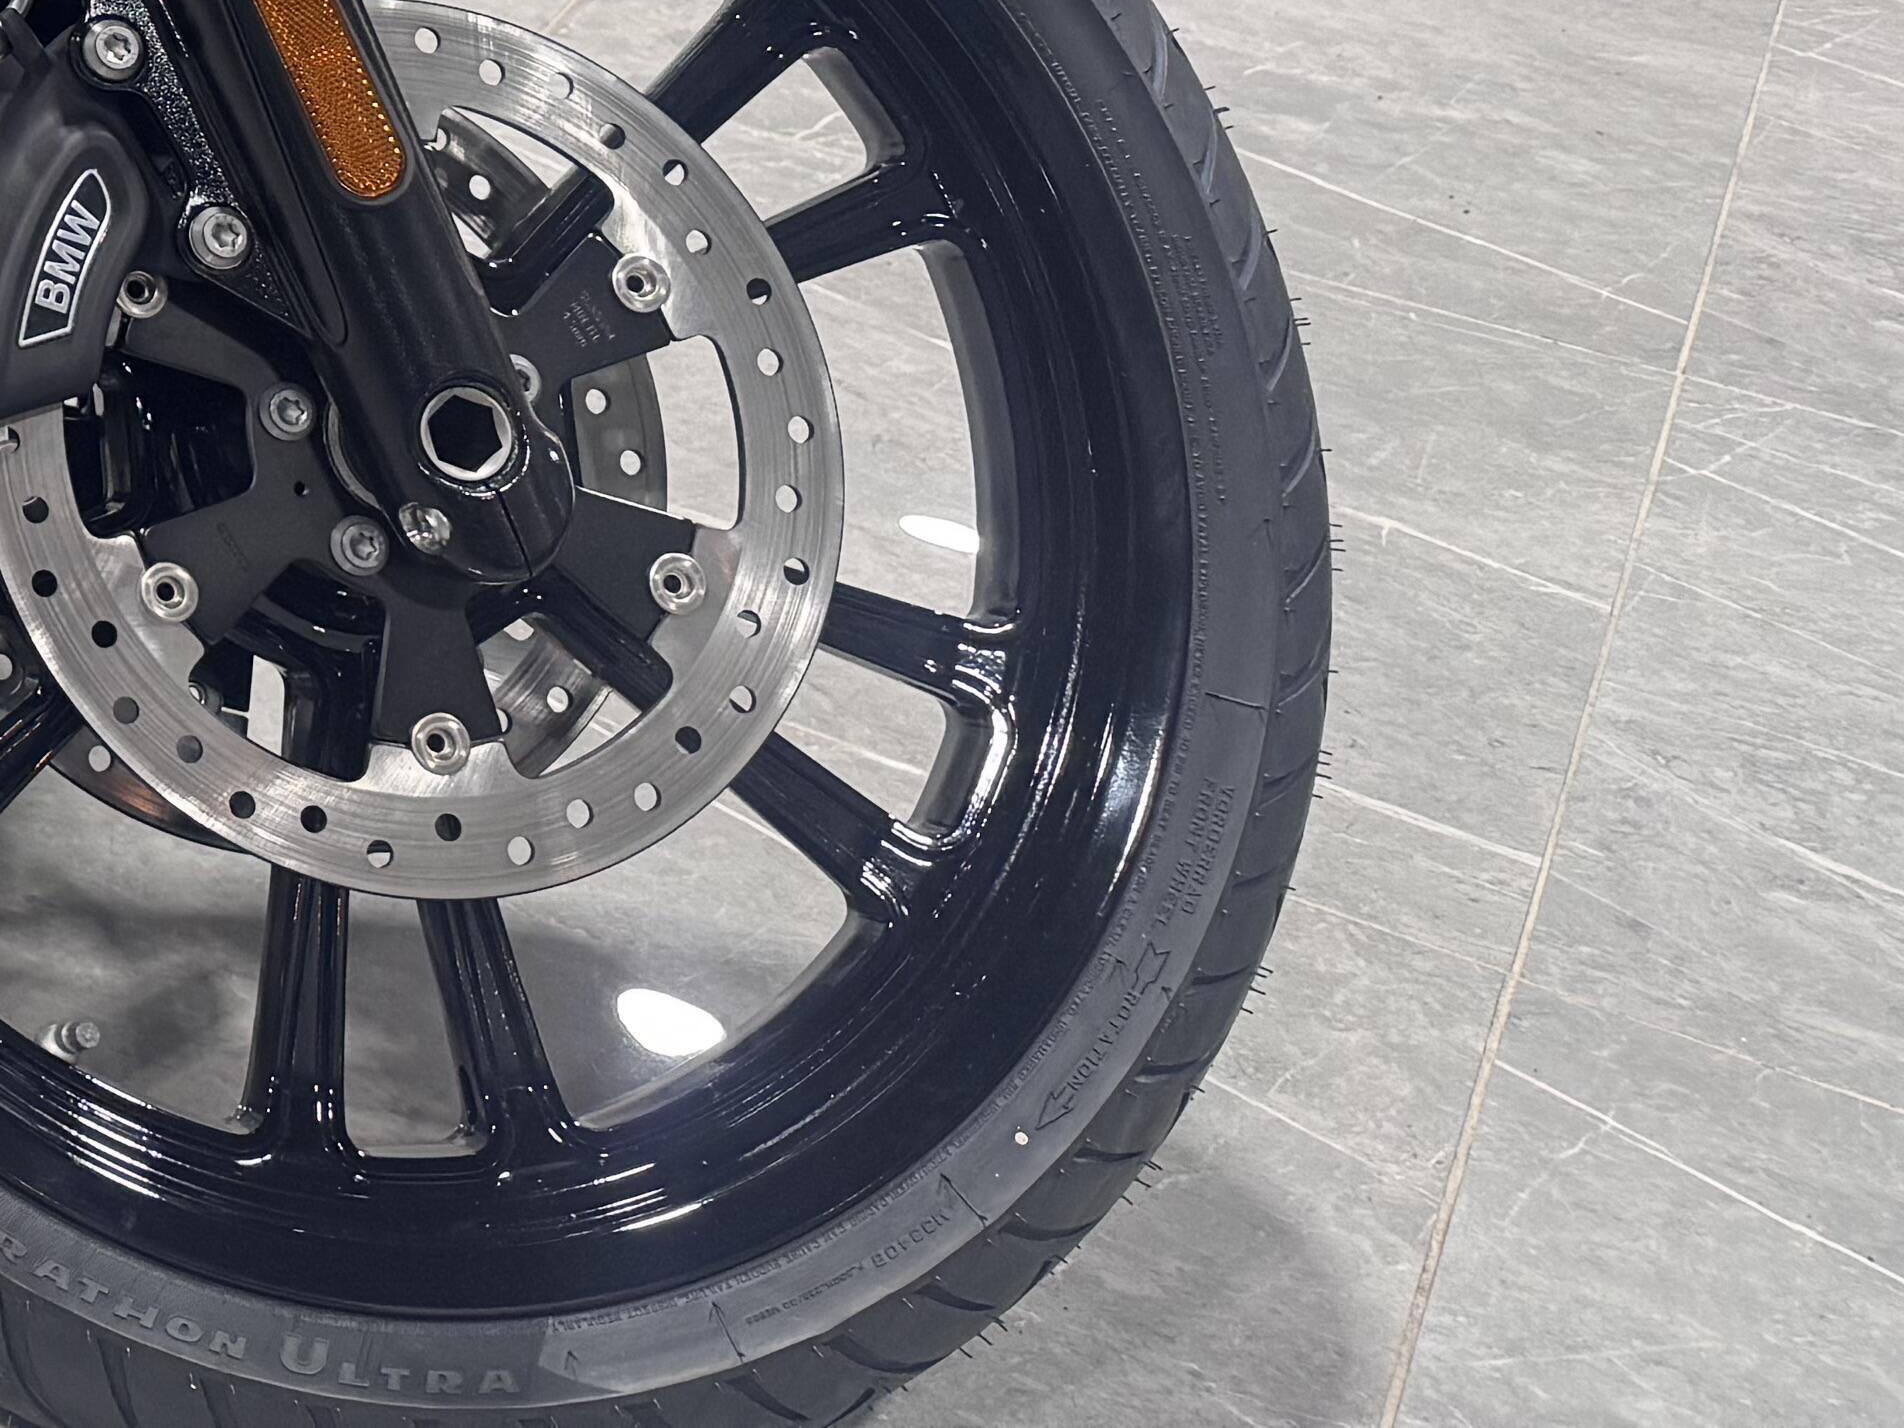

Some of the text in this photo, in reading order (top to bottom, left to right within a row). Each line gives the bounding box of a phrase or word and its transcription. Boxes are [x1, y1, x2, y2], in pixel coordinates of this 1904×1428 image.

[35, 199, 100, 314] BMW
[1157, 778, 1216, 926] FRONT WHEEL
[1183, 784, 1234, 915] VORDERRAD
[1069, 987, 1141, 1095] ROTATION
[279, 1336, 521, 1394] ULTRA
